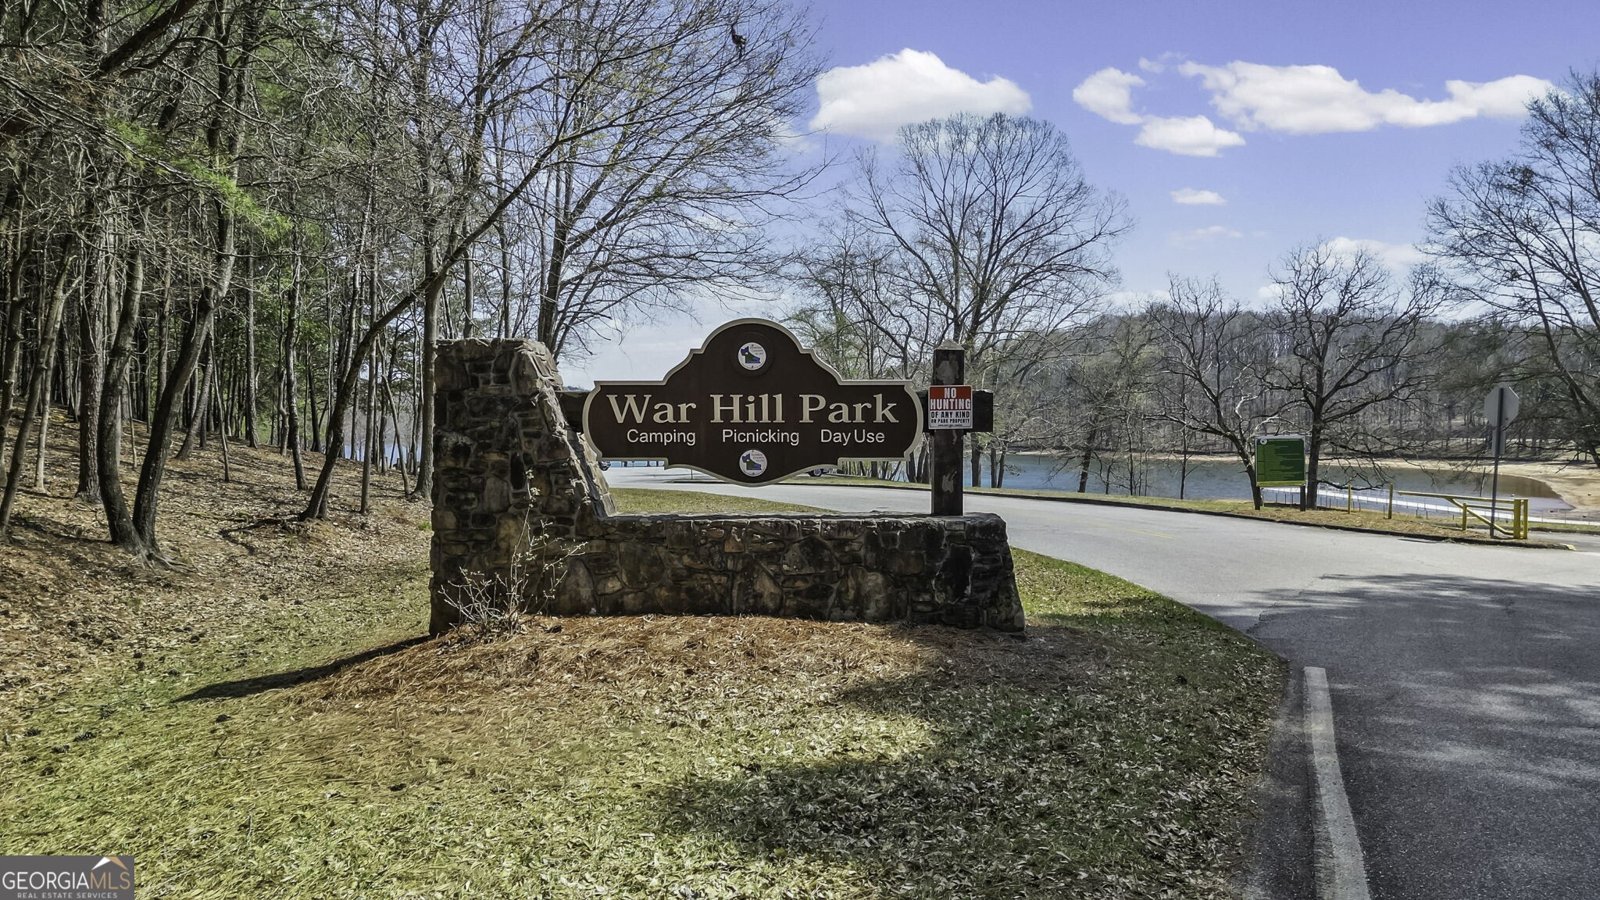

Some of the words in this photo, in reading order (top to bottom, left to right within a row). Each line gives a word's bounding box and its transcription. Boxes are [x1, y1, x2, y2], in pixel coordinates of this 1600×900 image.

[944, 388, 957, 398] NO
[606, 393, 697, 424] War
[709, 393, 786, 424] Hill
[799, 393, 899, 424] Park
[930, 398, 971, 409] HUNTING
[626, 428, 696, 446] Camping
[722, 428, 800, 446] Picnicking
[820, 428, 851, 446] Day
[854, 428, 885, 443] Use
